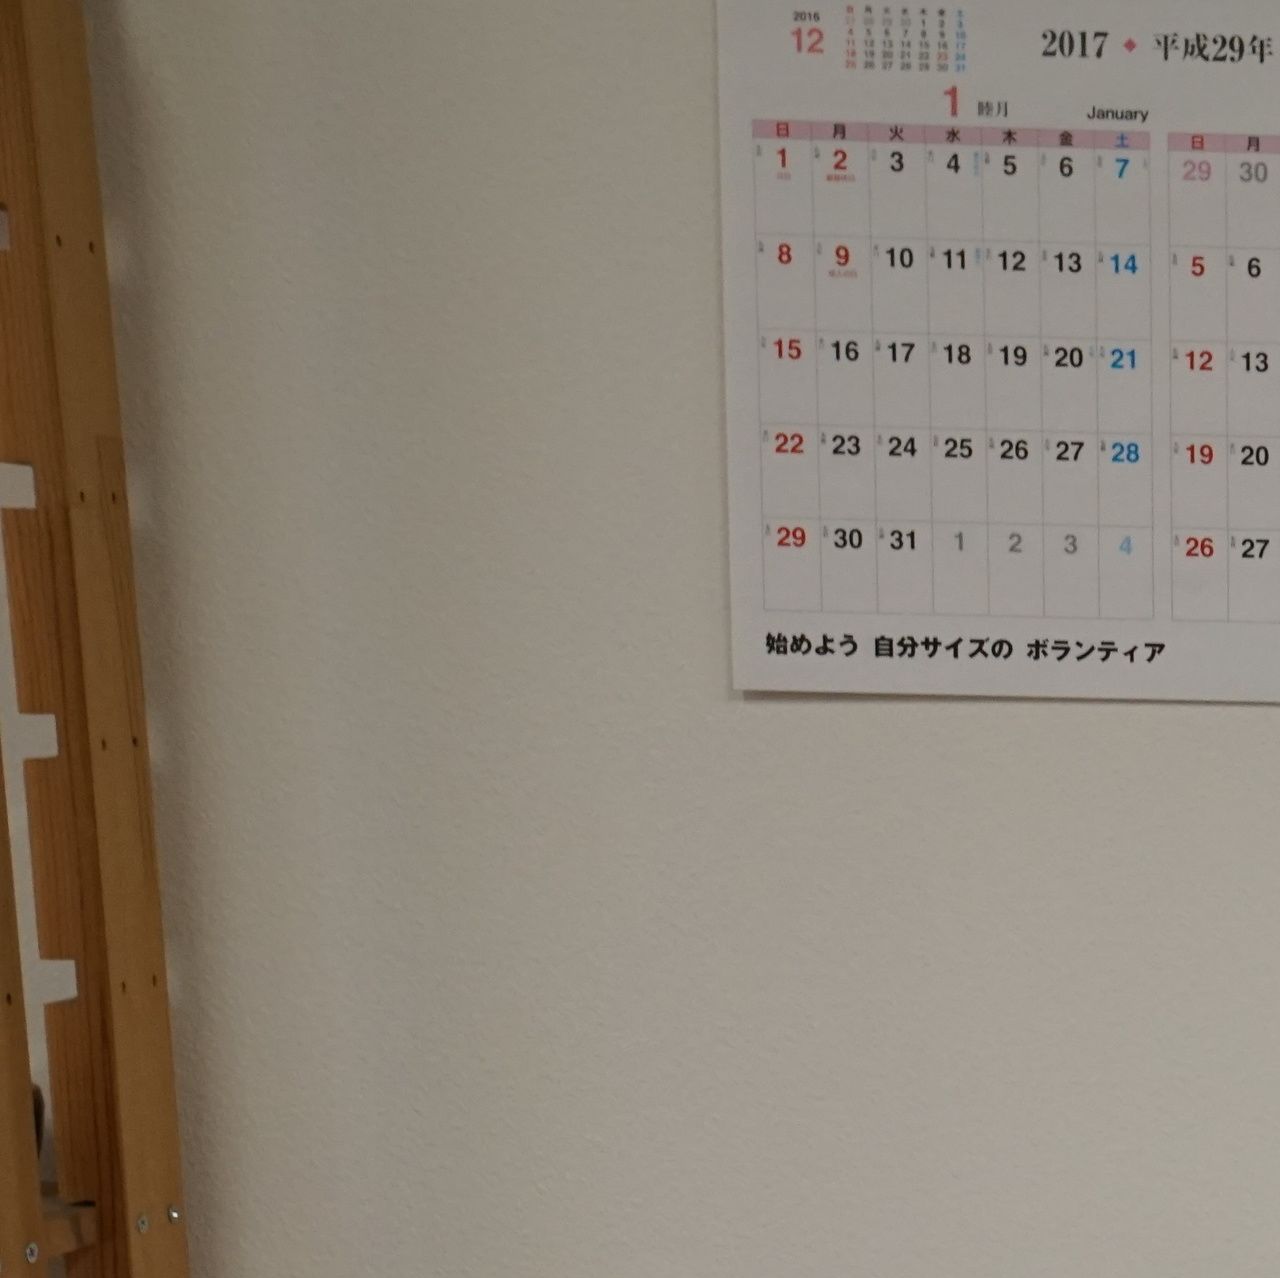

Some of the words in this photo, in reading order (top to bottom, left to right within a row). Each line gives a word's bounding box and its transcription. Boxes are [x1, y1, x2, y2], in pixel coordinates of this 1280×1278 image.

[792, 28, 823, 53] 12
[1042, 30, 1108, 58] 2017
[1156, 33, 1272, 63] 平成29年
[944, 86, 958, 117] 1
[978, 101, 1008, 117] 睦月
[1087, 106, 1148, 122] January
[776, 123, 789, 137] 日
[833, 125, 846, 139] 月
[889, 127, 904, 141] 火
[945, 128, 960, 142] 水
[1002, 130, 1017, 144] 木
[1058, 131, 1073, 145] 金
[1115, 133, 1130, 147] 土
[1191, 136, 1204, 150] 日
[1247, 138, 1260, 152] 月
[777, 148, 787, 167] 1
[833, 150, 848, 170] 2
[890, 152, 905, 172] 3
[946, 154, 961, 173] 4
[1003, 155, 1017, 175] 5
[1059, 157, 1074, 177] 6
[1115, 159, 1130, 178] 7
[1182, 162, 1212, 181] 29
[1238, 163, 1269, 182] 30
[777, 244, 793, 264] 8
[835, 246, 850, 266] 9
[886, 248, 914, 268] 10
[943, 249, 966, 269] 11
[998, 251, 1026, 270] 12
[1054, 253, 1082, 272] 13
[1111, 255, 1138, 273] 14
[1191, 256, 1205, 276] 5
[1247, 258, 1262, 277] 6
[774, 339, 802, 359] 15
[832, 341, 860, 361] 16
[887, 343, 916, 362] 17
[944, 344, 972, 364] 18
[1000, 346, 1028, 366] 19
[1054, 348, 1084, 367] 20
[1110, 349, 1136, 368] 21
[1186, 351, 1213, 370] 12
[1242, 352, 1269, 372] 13
[775, 433, 804, 453] 22
[832, 435, 861, 455] 23
[888, 437, 917, 456] 24
[944, 438, 973, 458] 25
[1000, 440, 1029, 459] 26
[1056, 441, 1085, 461] 27
[1110, 443, 1140, 462] 28
[1186, 445, 1214, 464] 19
[1240, 446, 1270, 465] 20
[777, 527, 807, 547] 29
[834, 529, 863, 548] 30
[890, 530, 916, 550] 31
[954, 532, 964, 551] 1
[1008, 533, 1022, 552] 2
[1063, 535, 1078, 554] 3
[1118, 536, 1133, 554] 4
[1185, 538, 1214, 557] 26
[1241, 539, 1270, 558] 27
[766, 633, 857, 656] 始めよう
[875, 636, 1013, 659] 自分サイズの
[1027, 639, 1165, 662] ボランティア
